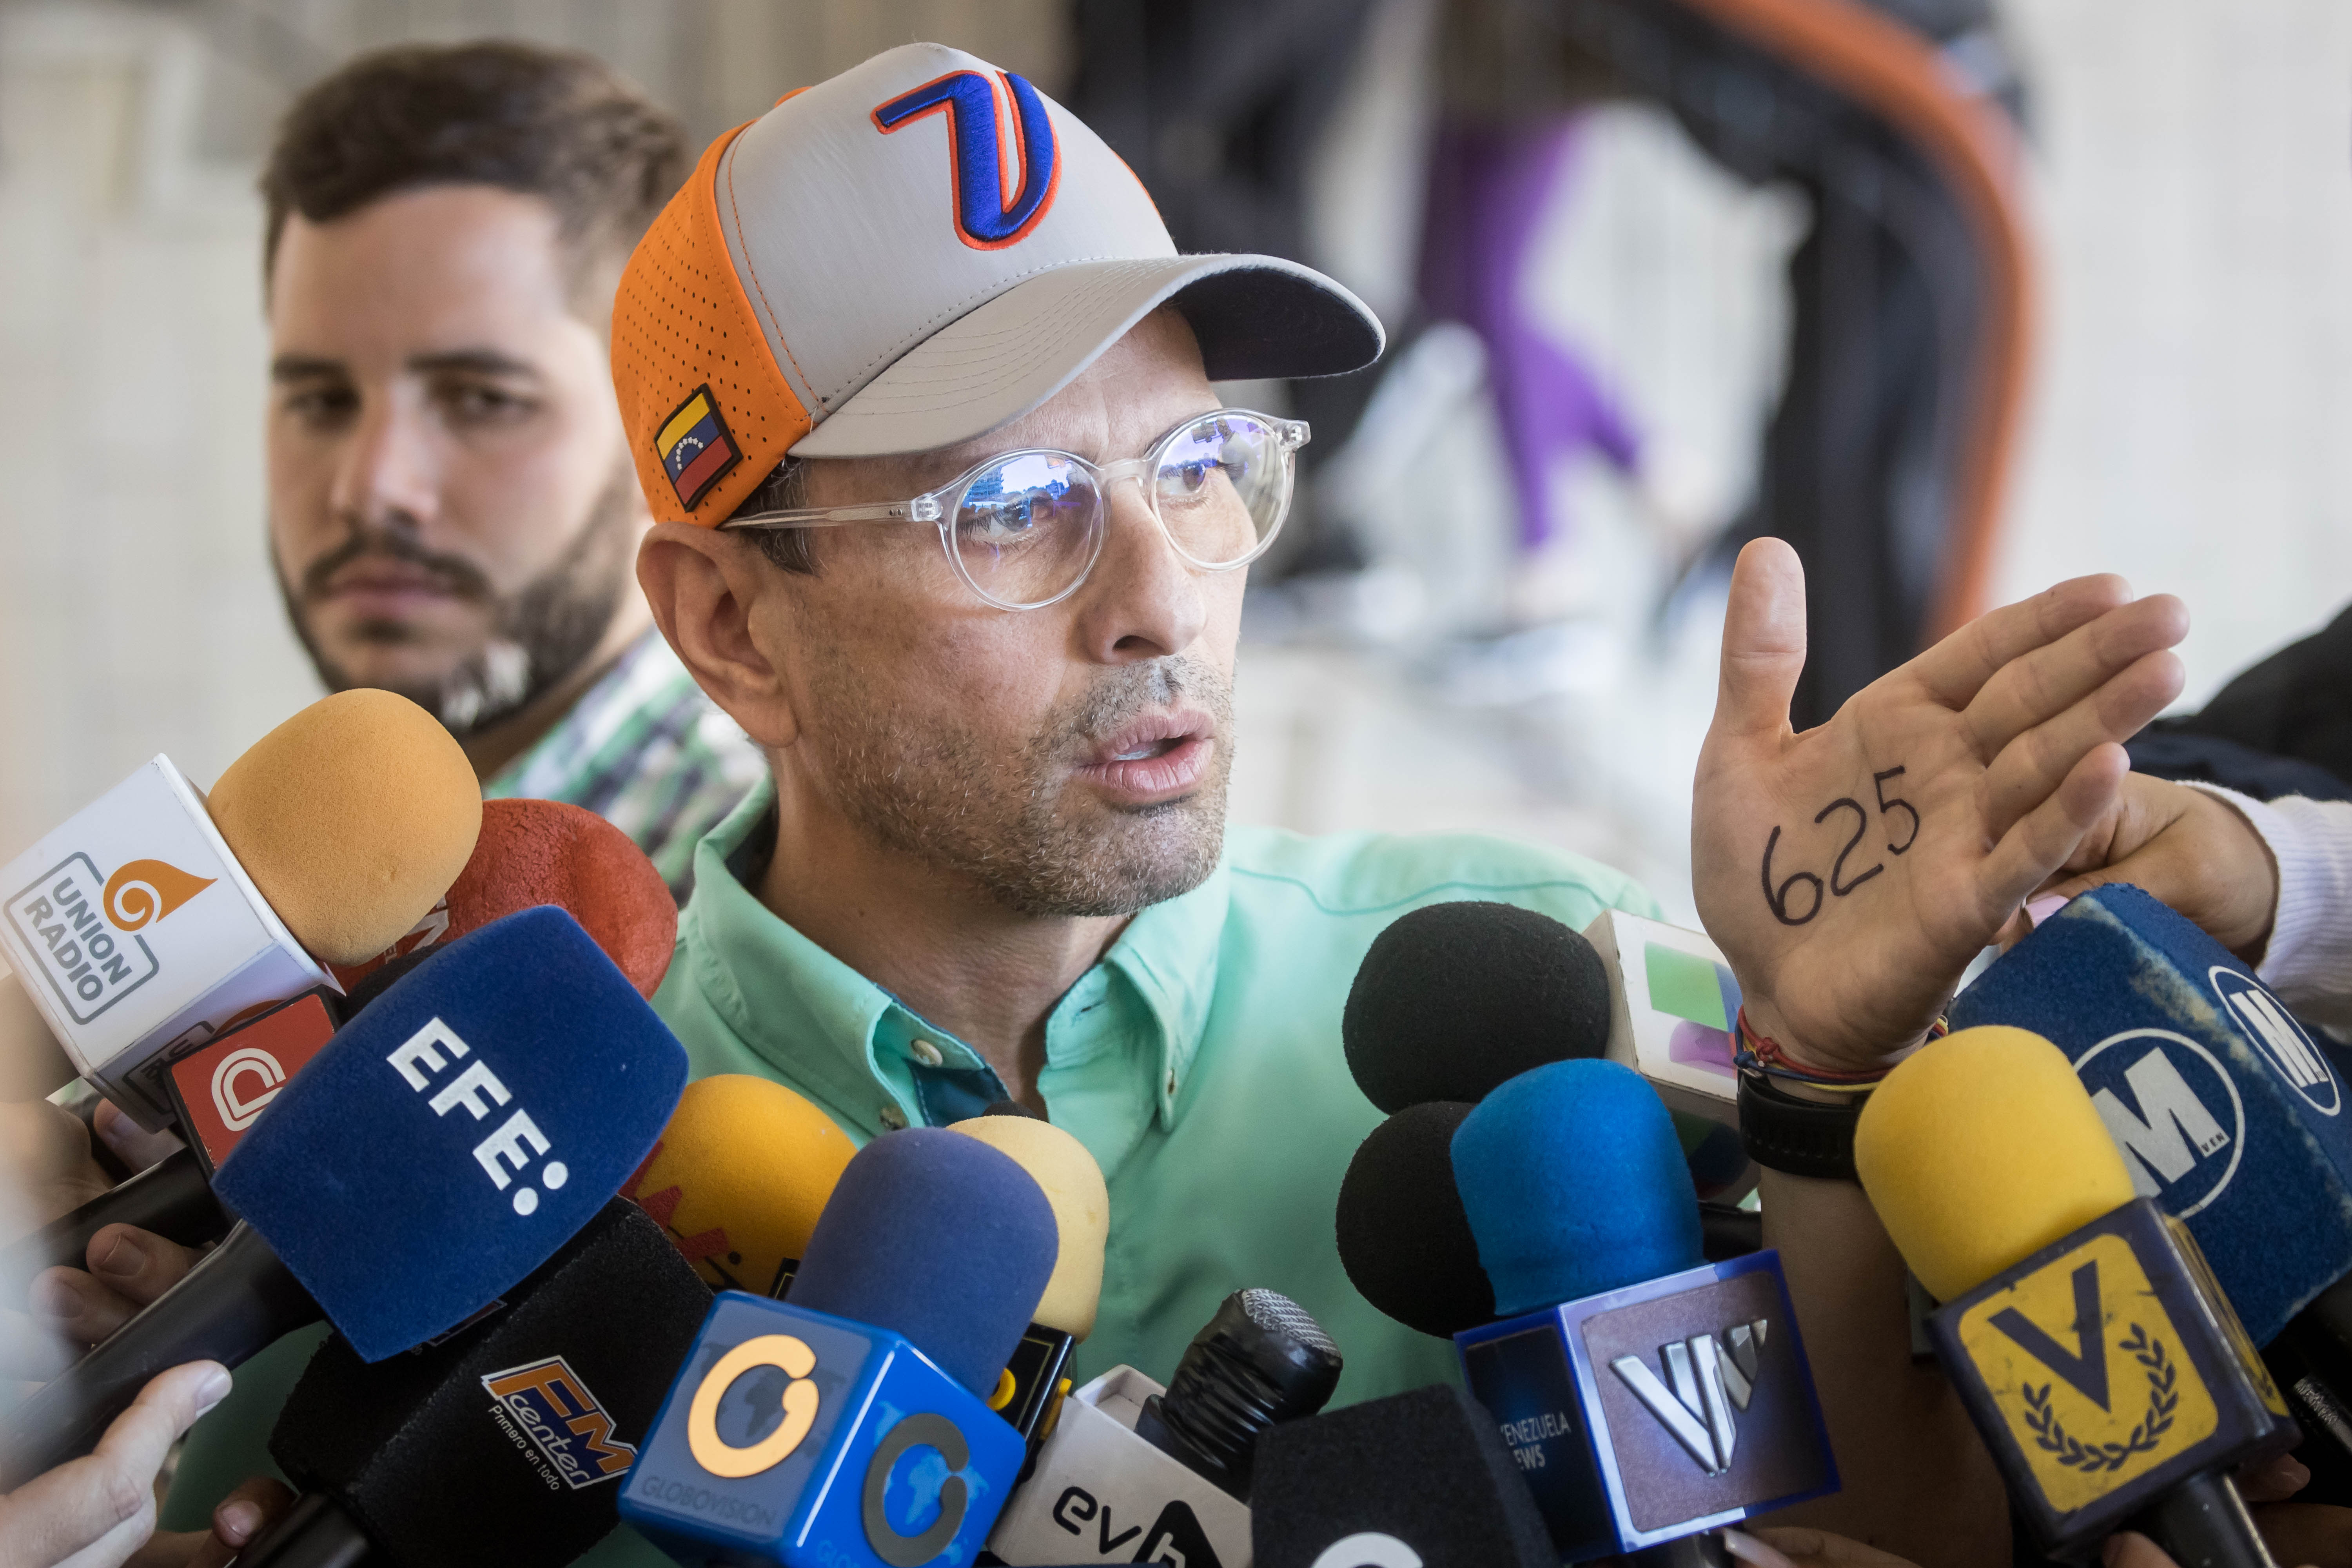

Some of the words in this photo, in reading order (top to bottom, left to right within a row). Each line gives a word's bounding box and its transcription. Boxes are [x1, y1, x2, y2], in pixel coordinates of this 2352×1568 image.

[1762, 765, 1920, 926] 625
[24, 895, 103, 1001] RADIO
[53, 877, 132, 985] UNION
[1987, 1259, 2111, 1414] V
[488, 1362, 635, 1475] FM
[488, 1405, 527, 1449] Primero
[525, 1449, 540, 1465] en
[537, 1464, 560, 1490] todo
[510, 1394, 590, 1480] center
[1500, 1412, 1572, 1447] ENEZUELA
[642, 1475, 778, 1526] GLOBOVISION
